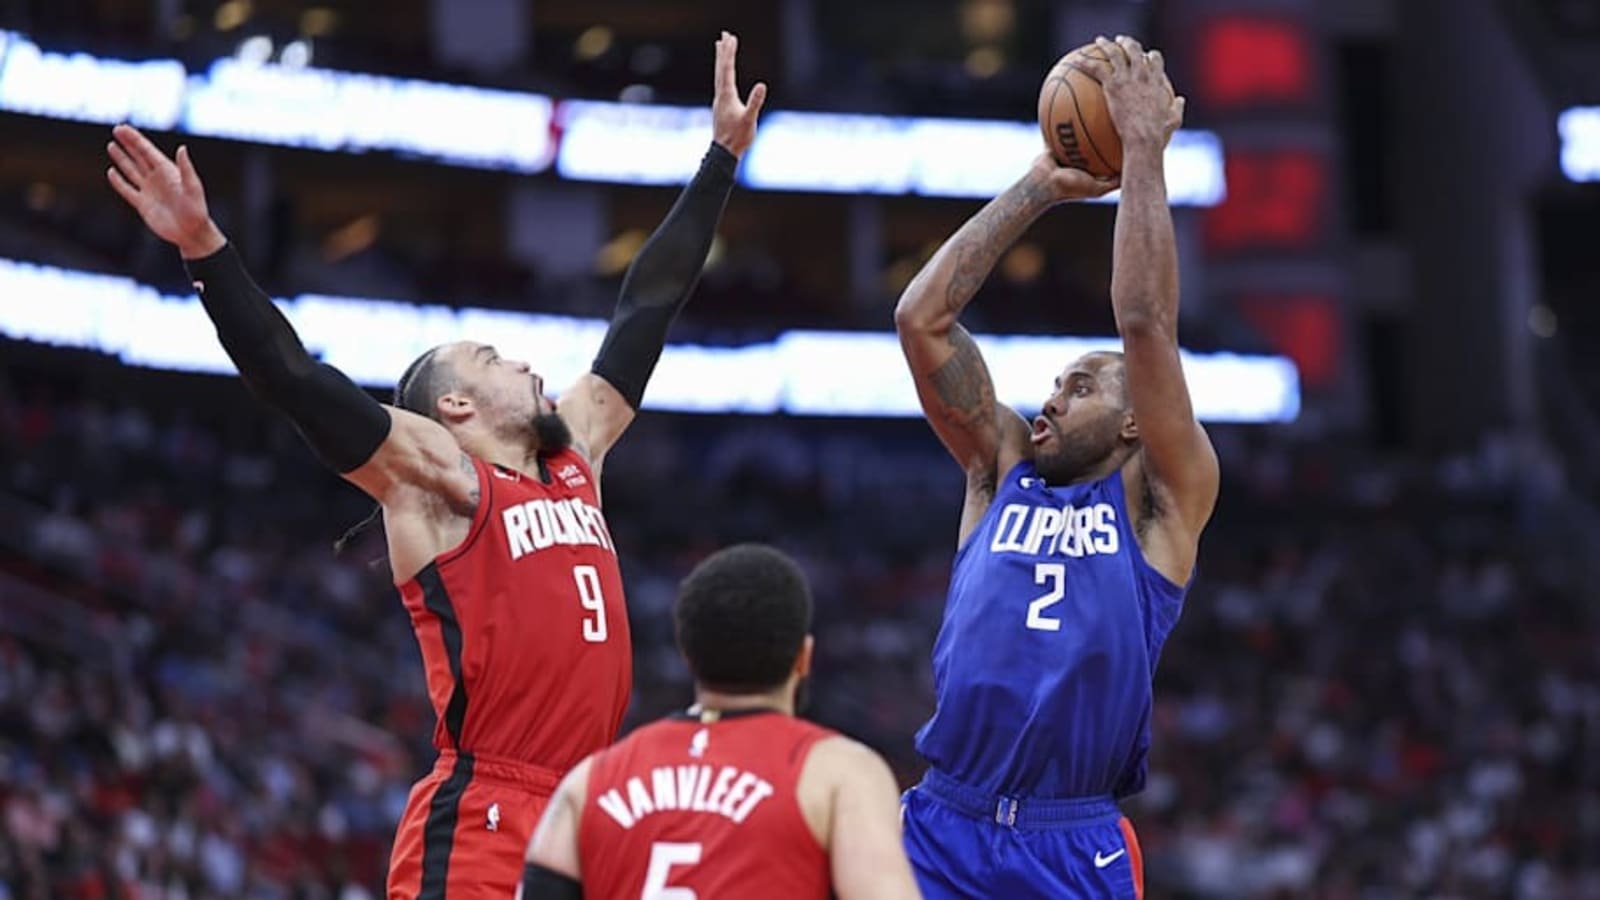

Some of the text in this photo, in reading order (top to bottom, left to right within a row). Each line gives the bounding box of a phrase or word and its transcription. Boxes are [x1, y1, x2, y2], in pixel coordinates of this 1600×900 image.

[502, 497, 616, 560] ROCKET
[573, 565, 607, 642] 9
[1026, 563, 1065, 631] 2
[597, 764, 774, 829] VANVLEET
[640, 842, 702, 900] 5
